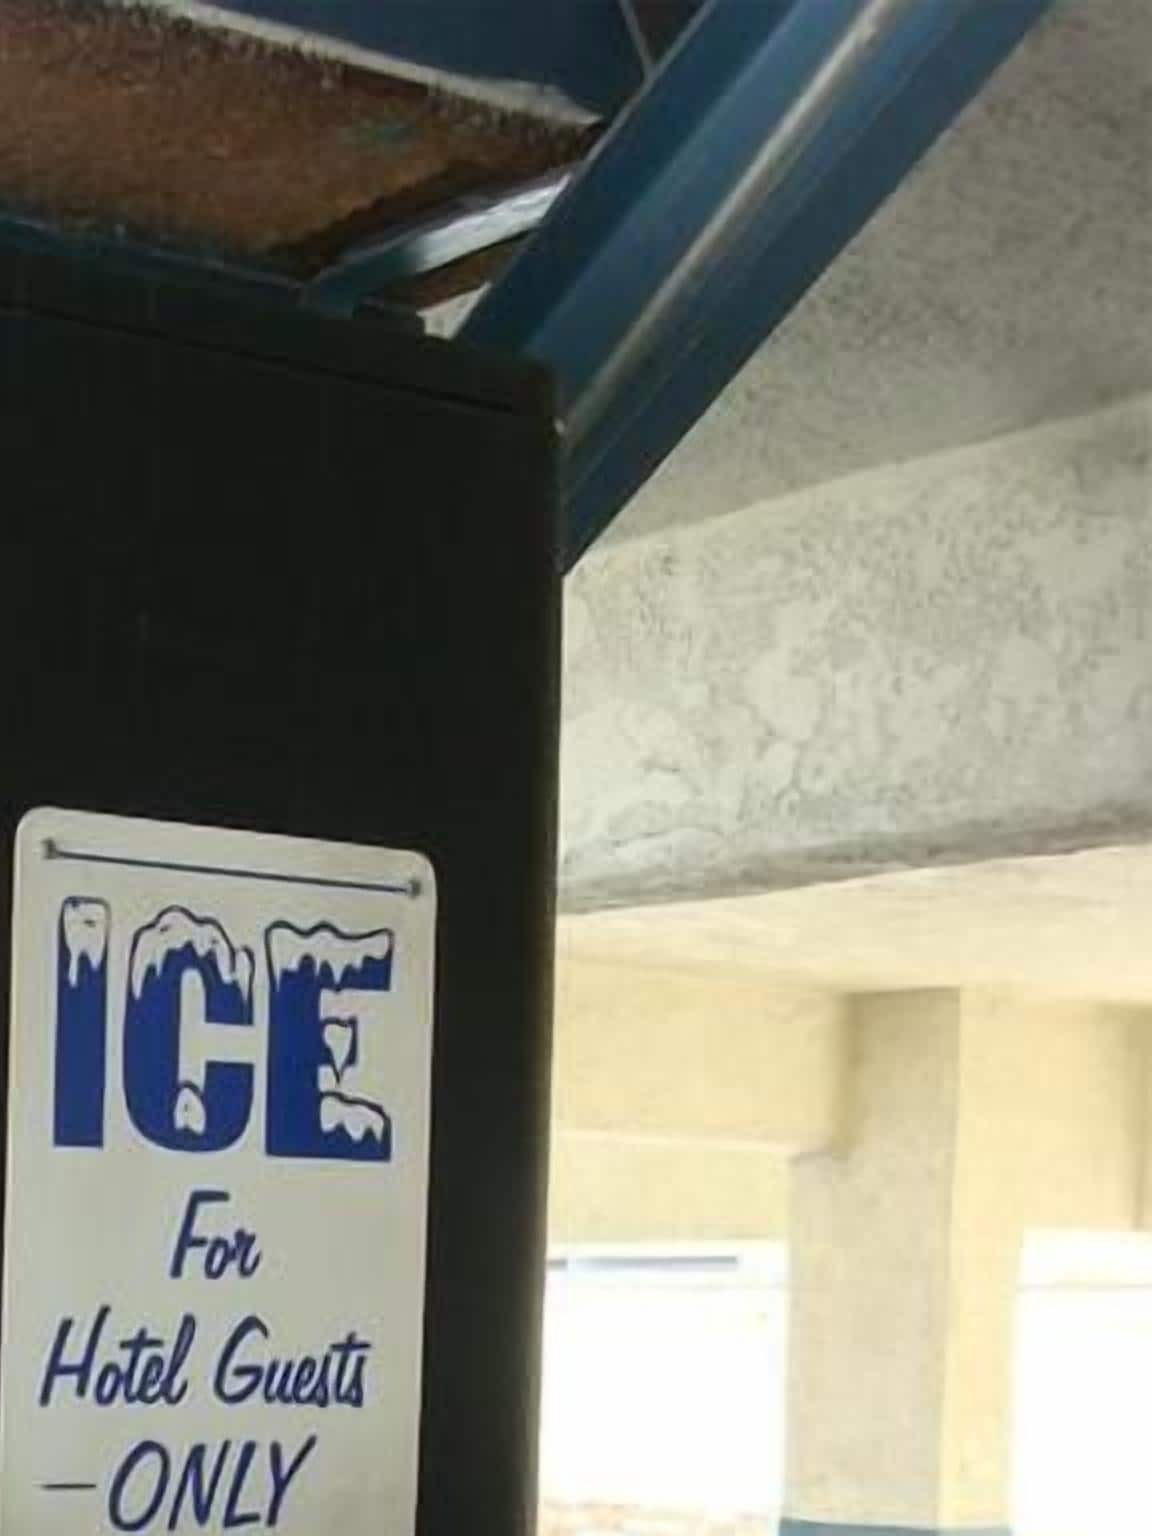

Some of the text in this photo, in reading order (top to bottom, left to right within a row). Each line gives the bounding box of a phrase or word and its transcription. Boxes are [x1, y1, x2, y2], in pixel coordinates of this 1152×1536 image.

[53, 896, 395, 1162] ICE
[170, 1190, 262, 1279] For
[39, 1304, 372, 1408] Hotel Guests
[108, 1435, 317, 1532] ONLY
